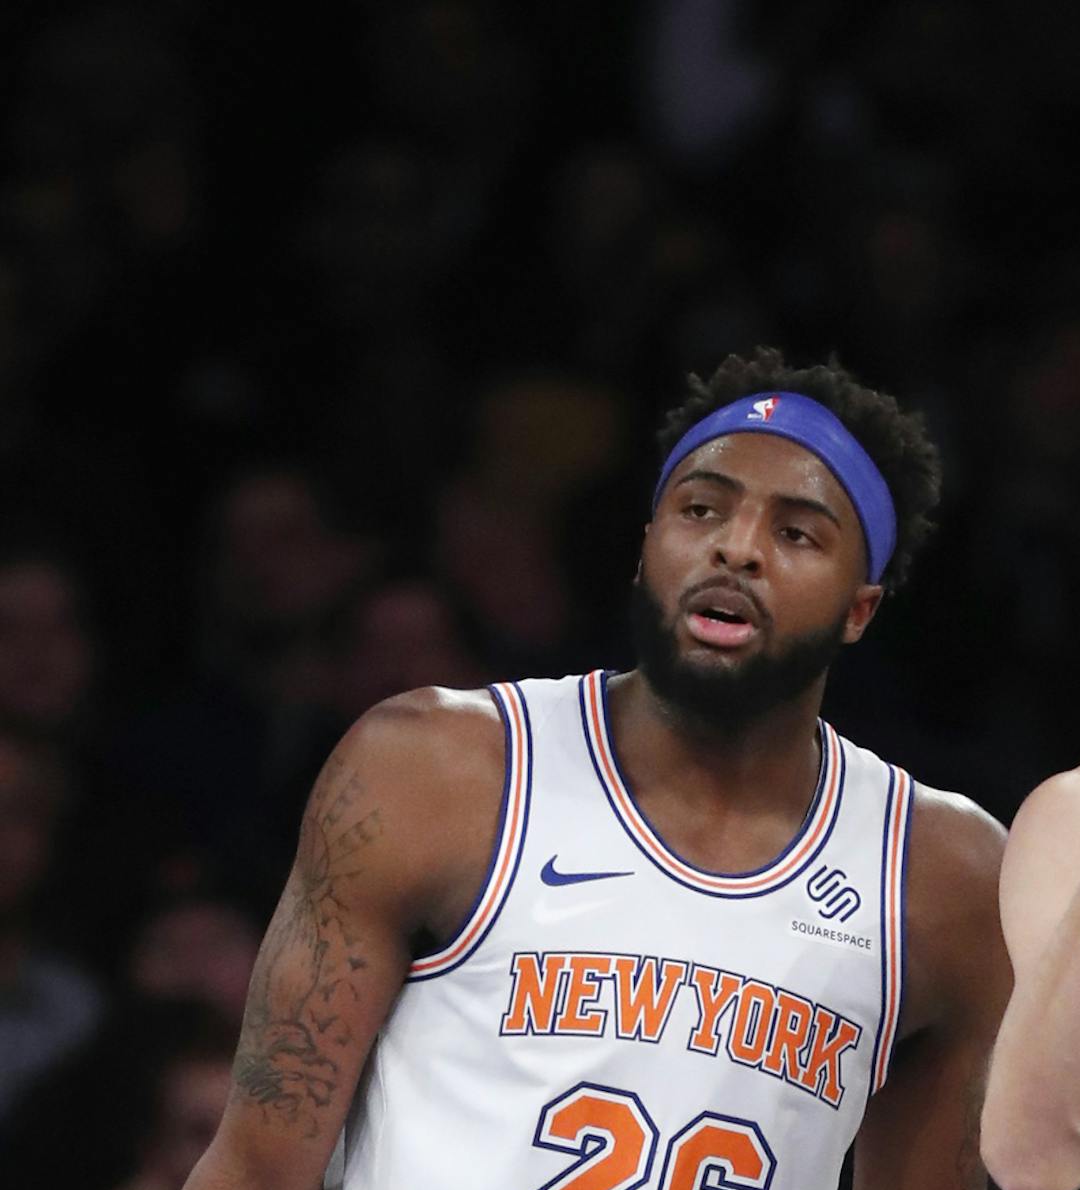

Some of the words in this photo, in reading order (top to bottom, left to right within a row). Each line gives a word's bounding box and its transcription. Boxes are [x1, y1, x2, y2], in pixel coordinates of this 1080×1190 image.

[791, 920, 872, 950] SQUARESPACE
[499, 952, 689, 1044] NEW
[687, 961, 862, 1110] YORK
